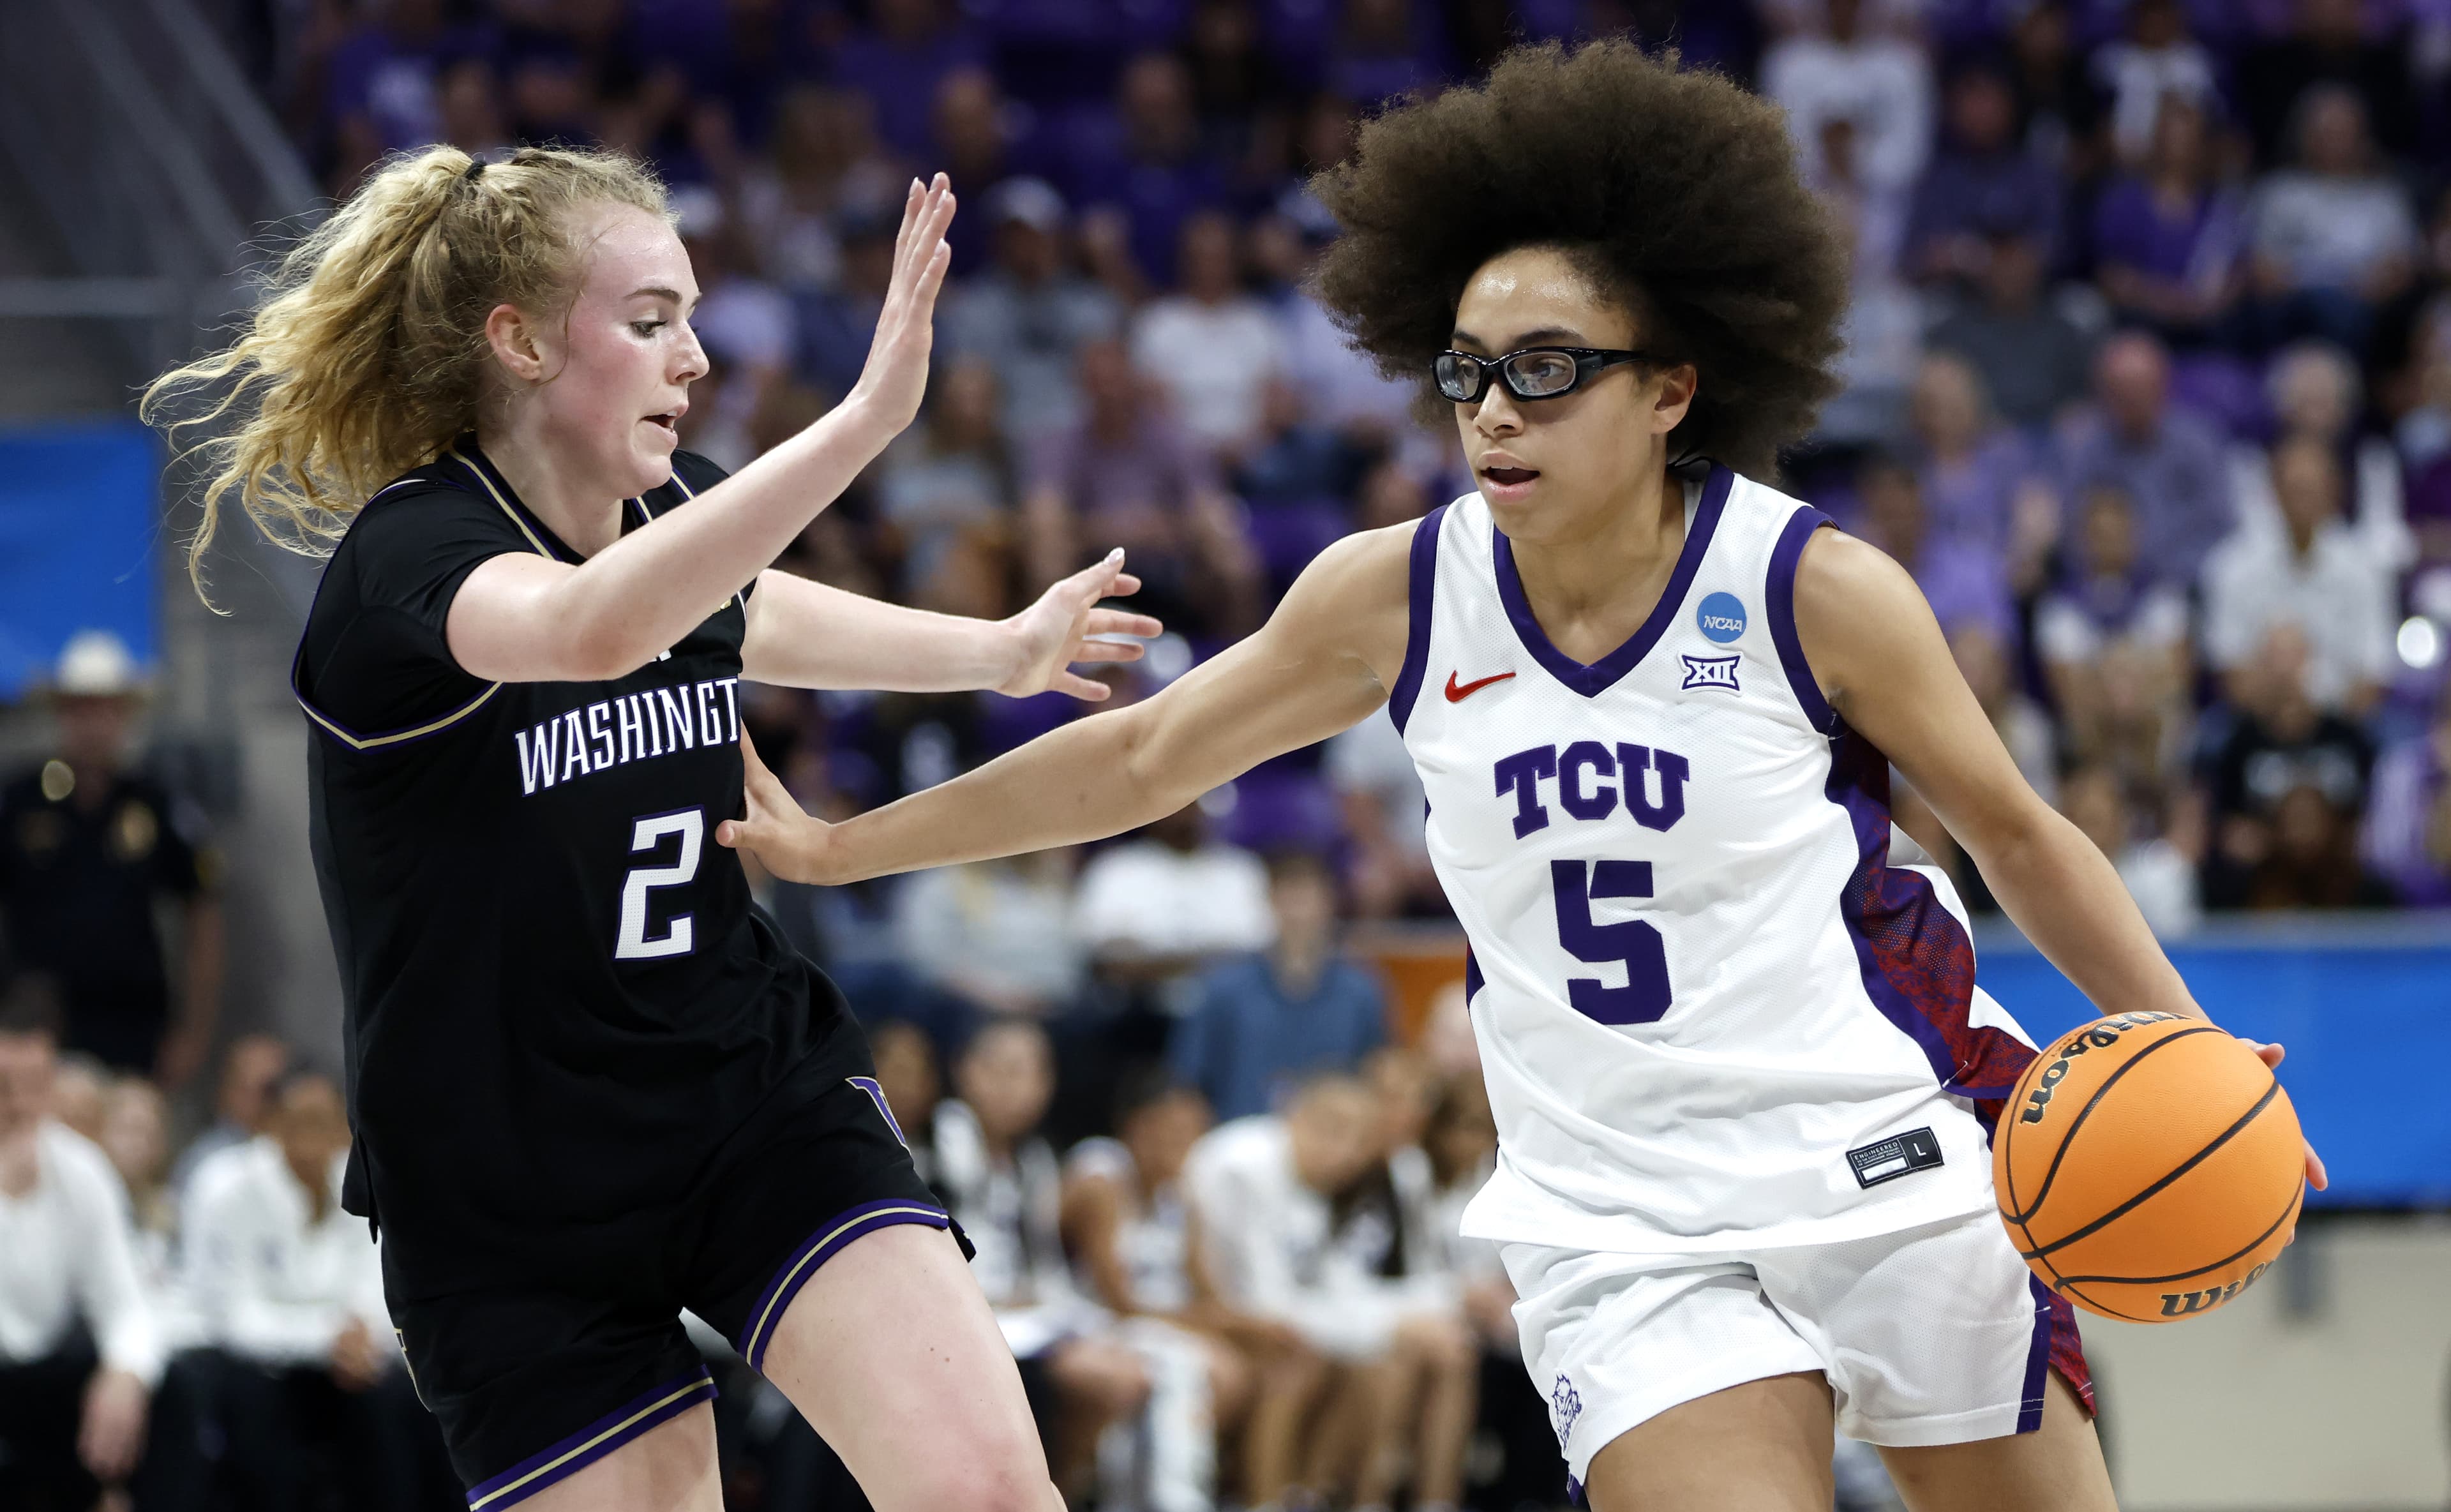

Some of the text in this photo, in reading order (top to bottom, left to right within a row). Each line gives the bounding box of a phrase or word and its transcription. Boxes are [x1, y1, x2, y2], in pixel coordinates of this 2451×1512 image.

[1703, 615, 1743, 632] NCAA
[1685, 658, 1737, 687] XII
[1494, 740, 1690, 840] TCU
[613, 804, 705, 960] 2
[1550, 859, 1672, 1025] 5
[1854, 1141, 1898, 1160] ENGINEERED
[1913, 1142, 1927, 1156] L
[2159, 1259, 2273, 1317] Wil
